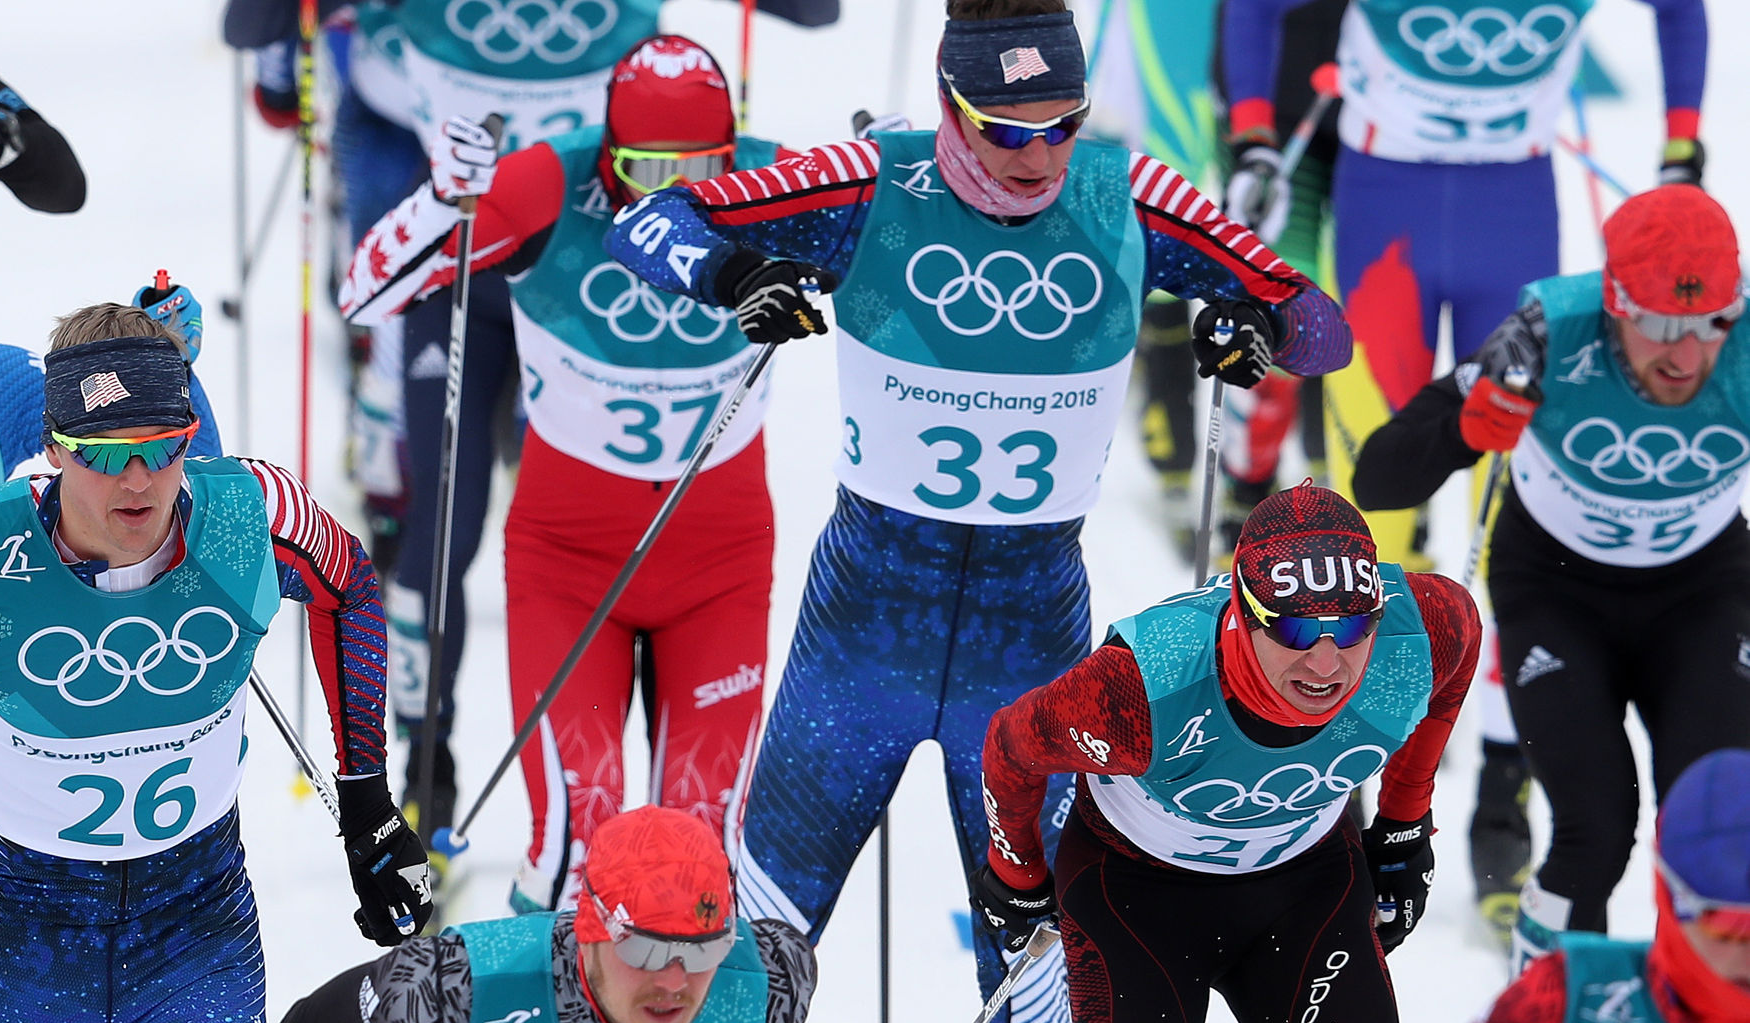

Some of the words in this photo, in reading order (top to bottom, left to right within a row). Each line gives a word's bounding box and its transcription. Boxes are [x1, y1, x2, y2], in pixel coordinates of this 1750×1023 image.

[1217, 349, 1243, 371] TOKO
[883, 375, 1047, 414] PyeongChang
[1050, 388, 1098, 409] 2018
[604, 392, 724, 464] 37
[913, 426, 1059, 515] 33
[1579, 511, 1698, 553] 35
[58, 757, 197, 847] 26
[1402, 899, 1414, 929] odlo
